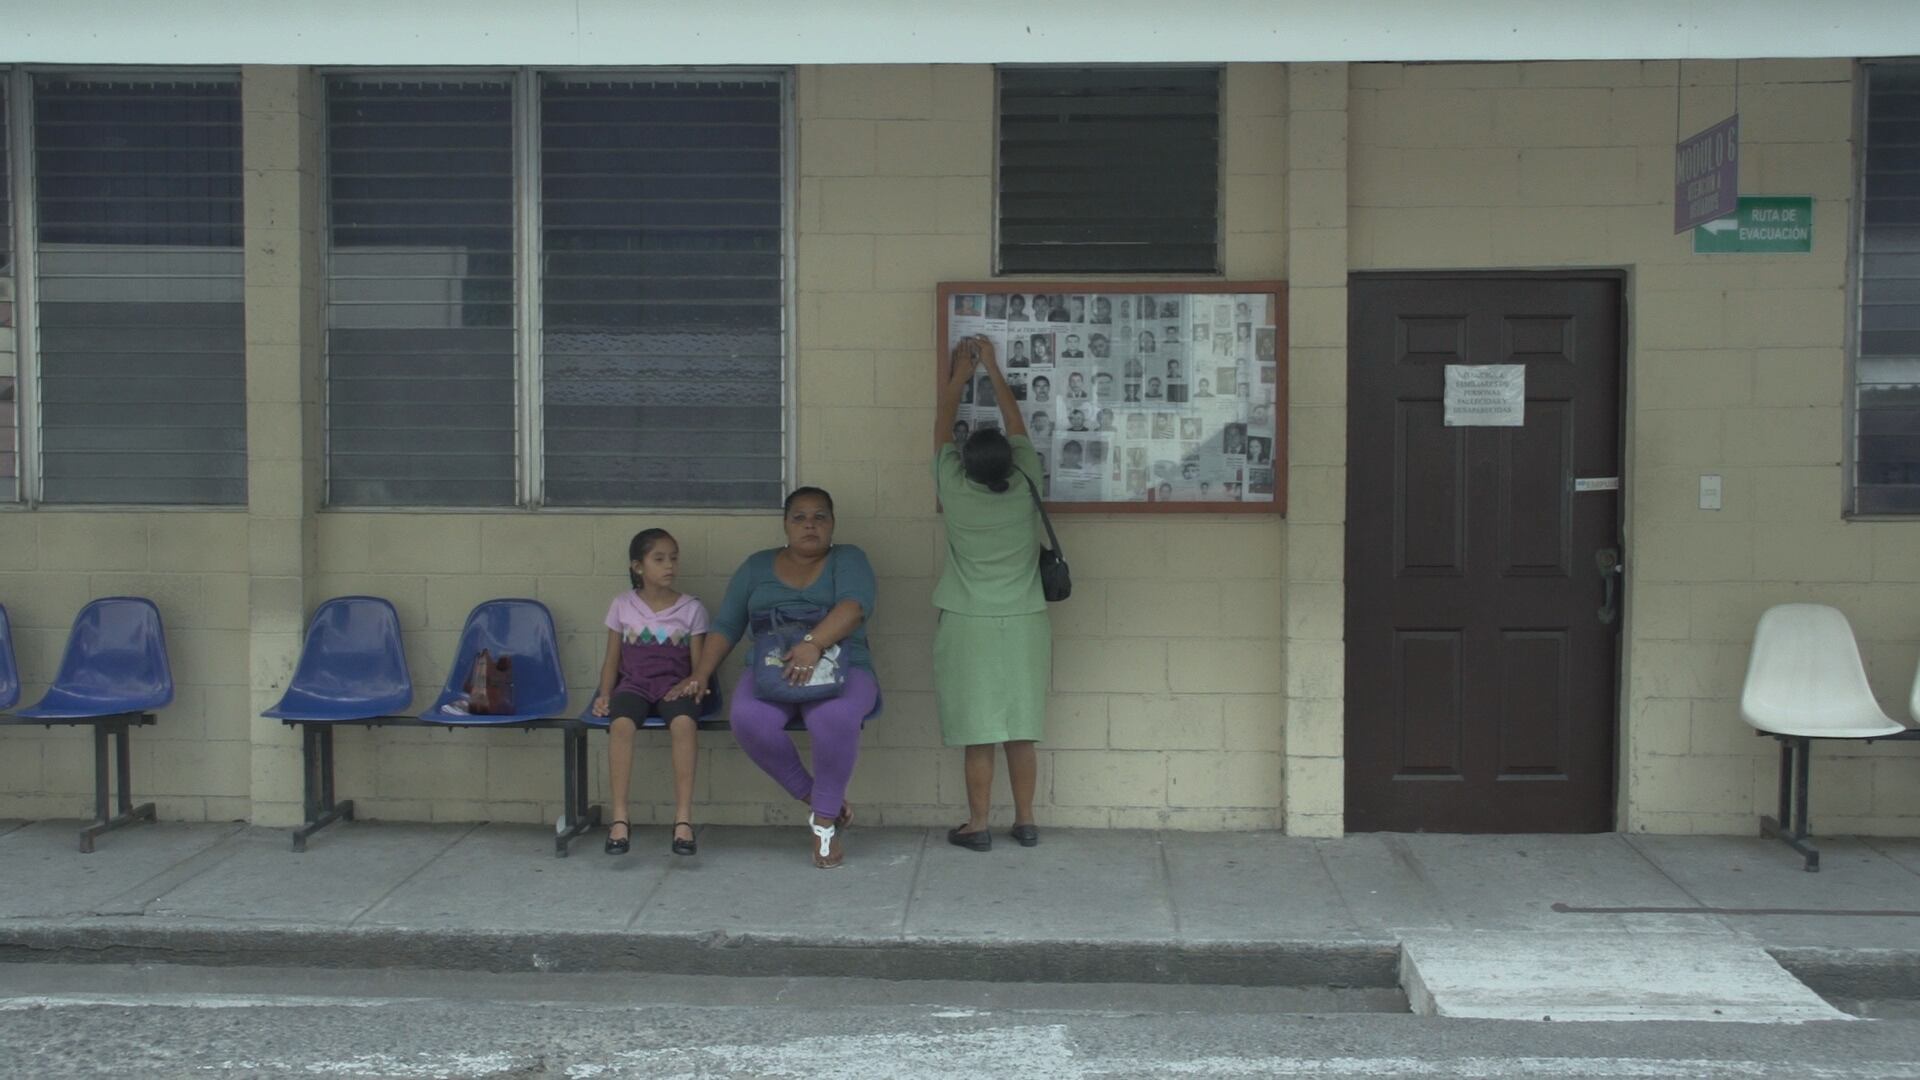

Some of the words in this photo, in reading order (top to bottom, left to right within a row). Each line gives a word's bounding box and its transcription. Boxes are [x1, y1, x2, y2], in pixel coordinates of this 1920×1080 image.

[1728, 126, 1736, 162] 6
[1752, 209, 1779, 222] RUTA
[1781, 208, 1797, 221] DE
[1739, 226, 1808, 241] EVACUACIÓN
